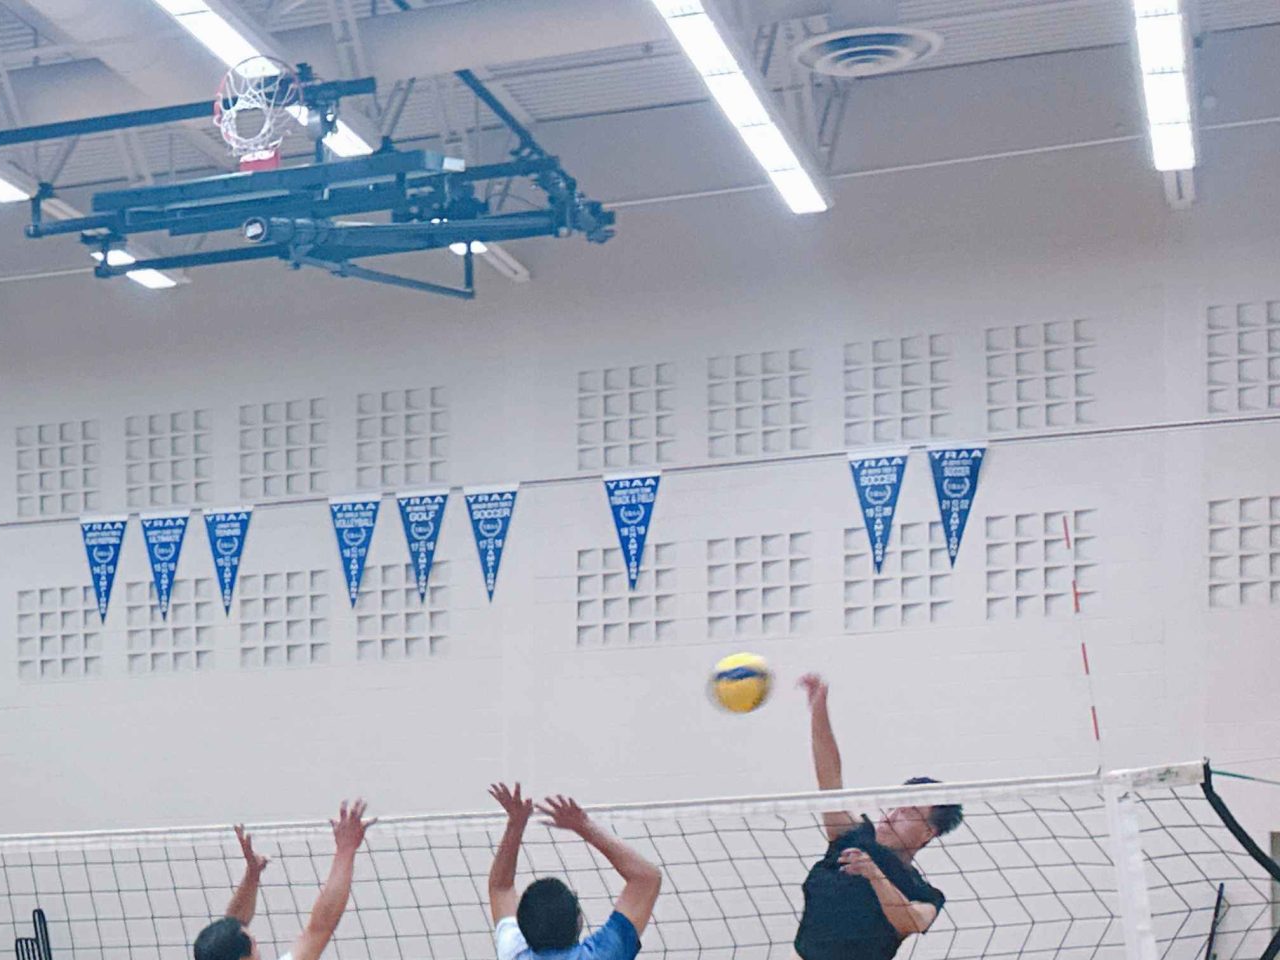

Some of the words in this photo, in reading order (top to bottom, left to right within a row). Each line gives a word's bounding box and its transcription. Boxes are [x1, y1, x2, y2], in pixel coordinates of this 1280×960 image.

[931, 450, 982, 459] YRAA
[852, 458, 903, 468] YRAA
[944, 466, 970, 476] SOCCER
[607, 478, 656, 489] YRAA
[860, 474, 897, 486] SOCCER
[399, 496, 444, 506] YRAA
[467, 493, 513, 503] YRAA
[332, 503, 376, 512] YRAA
[206, 513, 248, 522] YRAA
[409, 511, 436, 521] GOLF
[472, 508, 510, 520] SOCCER
[83, 523, 123, 531] YRAA
[143, 519, 185, 527] YRAA
[874, 505, 884, 562] CHAMPIONS
[949, 500, 959, 557] CHAMPIONS
[629, 526, 638, 580] CHAMPIONS
[418, 541, 427, 593] CHAMPIONS
[487, 537, 495, 591] CHAMPIONS
[350, 547, 358, 598] CHAMPIONS
